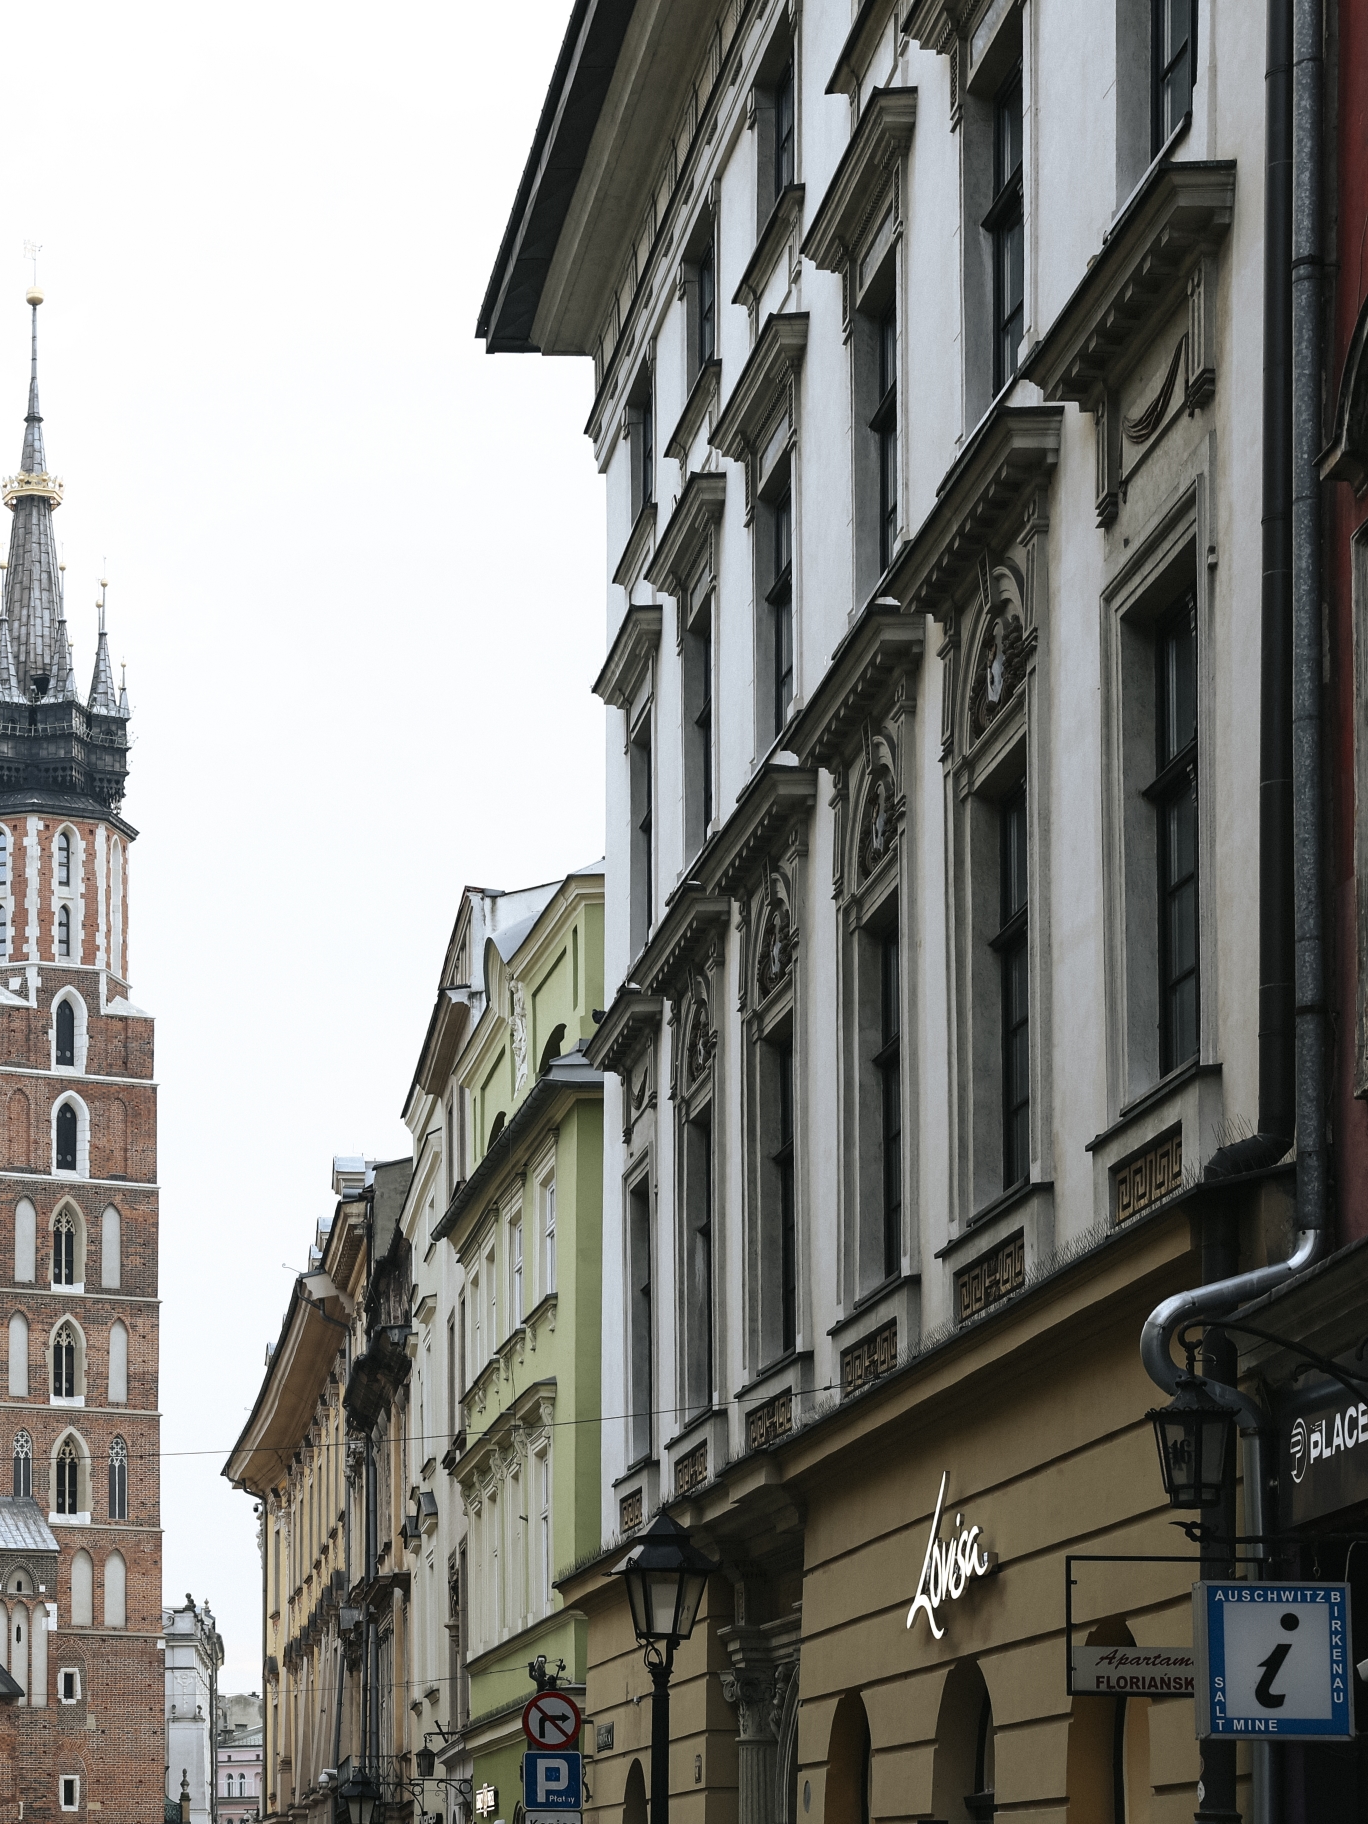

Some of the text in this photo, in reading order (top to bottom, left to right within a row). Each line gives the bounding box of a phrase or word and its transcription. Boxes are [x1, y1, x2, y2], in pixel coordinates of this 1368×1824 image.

[907, 1471, 989, 1640] Lovisa
[1215, 1590, 1325, 1602] AUSCHWITZ
[1331, 1592, 1344, 1703] BIRKENAU
[1095, 1673, 1194, 1691] FLORIAŃSK
[1214, 1677, 1225, 1731] SALT
[1233, 1720, 1278, 1731] MINE
[536, 1759, 569, 1803] P
